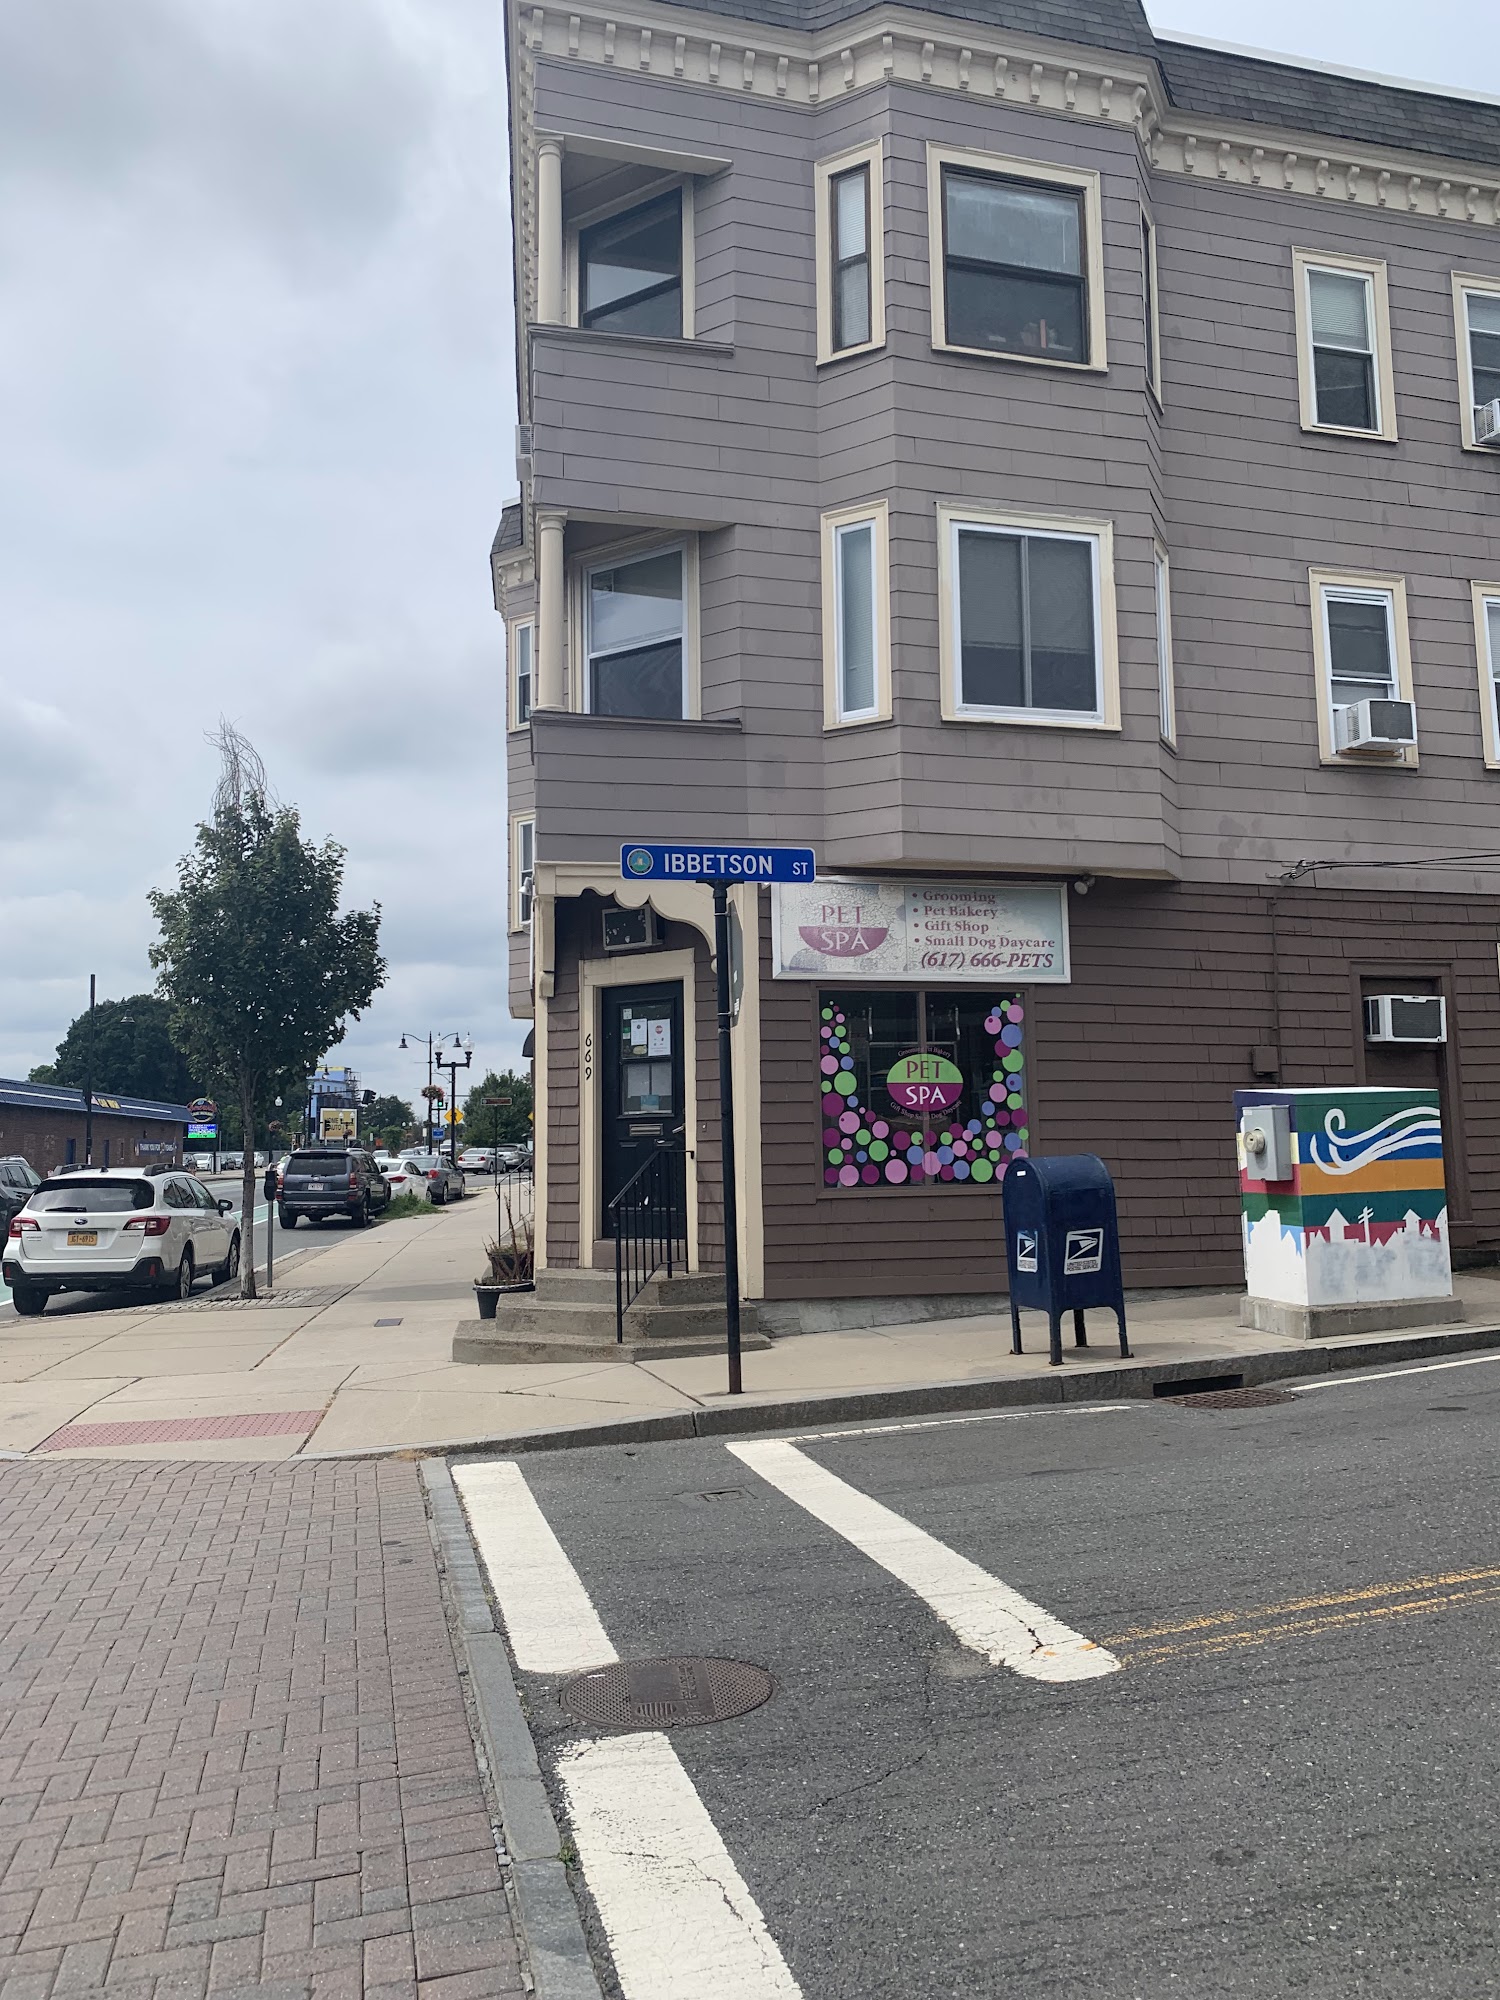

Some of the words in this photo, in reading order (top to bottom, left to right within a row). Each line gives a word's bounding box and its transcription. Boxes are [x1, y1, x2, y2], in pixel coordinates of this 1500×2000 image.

[664, 853, 773, 875] IBBETSON
[792, 861, 809, 876] ST
[923, 890, 996, 904] Grooming
[821, 904, 865, 924] PET
[924, 905, 945, 916] Pet
[949, 906, 998, 919] Bakery
[924, 920, 950, 932] Gift
[954, 920, 989, 934] Shop
[820, 928, 870, 951] SPA
[925, 935, 964, 947] Small
[968, 936, 996, 949] Dog
[1000, 937, 1056, 950] Daycare
[921, 951, 965, 969] (617)
[970, 952, 1054, 968] 666-PETS
[584, 1033, 592, 1081] 669
[907, 1061, 943, 1078] PET
[906, 1086, 946, 1105] SPA
